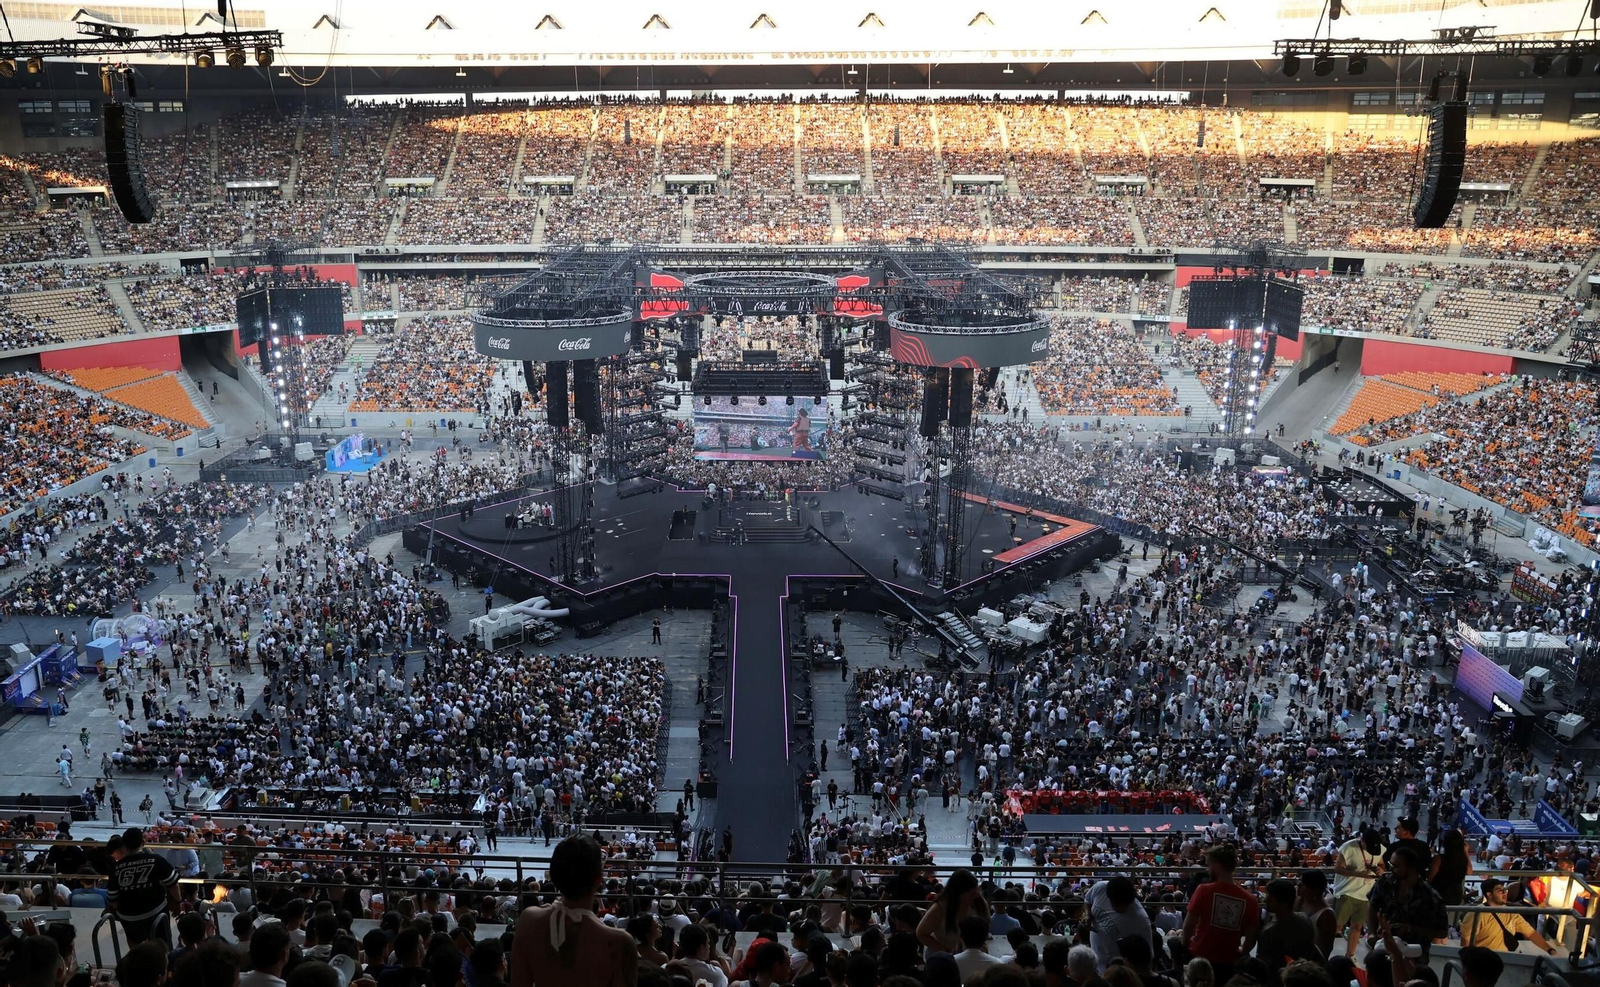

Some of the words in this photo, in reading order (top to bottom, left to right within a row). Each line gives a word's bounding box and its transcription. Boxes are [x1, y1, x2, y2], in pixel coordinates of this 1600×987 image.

[488, 336, 510, 350] Coca-Cola
[558, 337, 592, 351] Coca-Cola
[127, 858, 156, 867] ANGELES
[118, 864, 155, 887] 67
